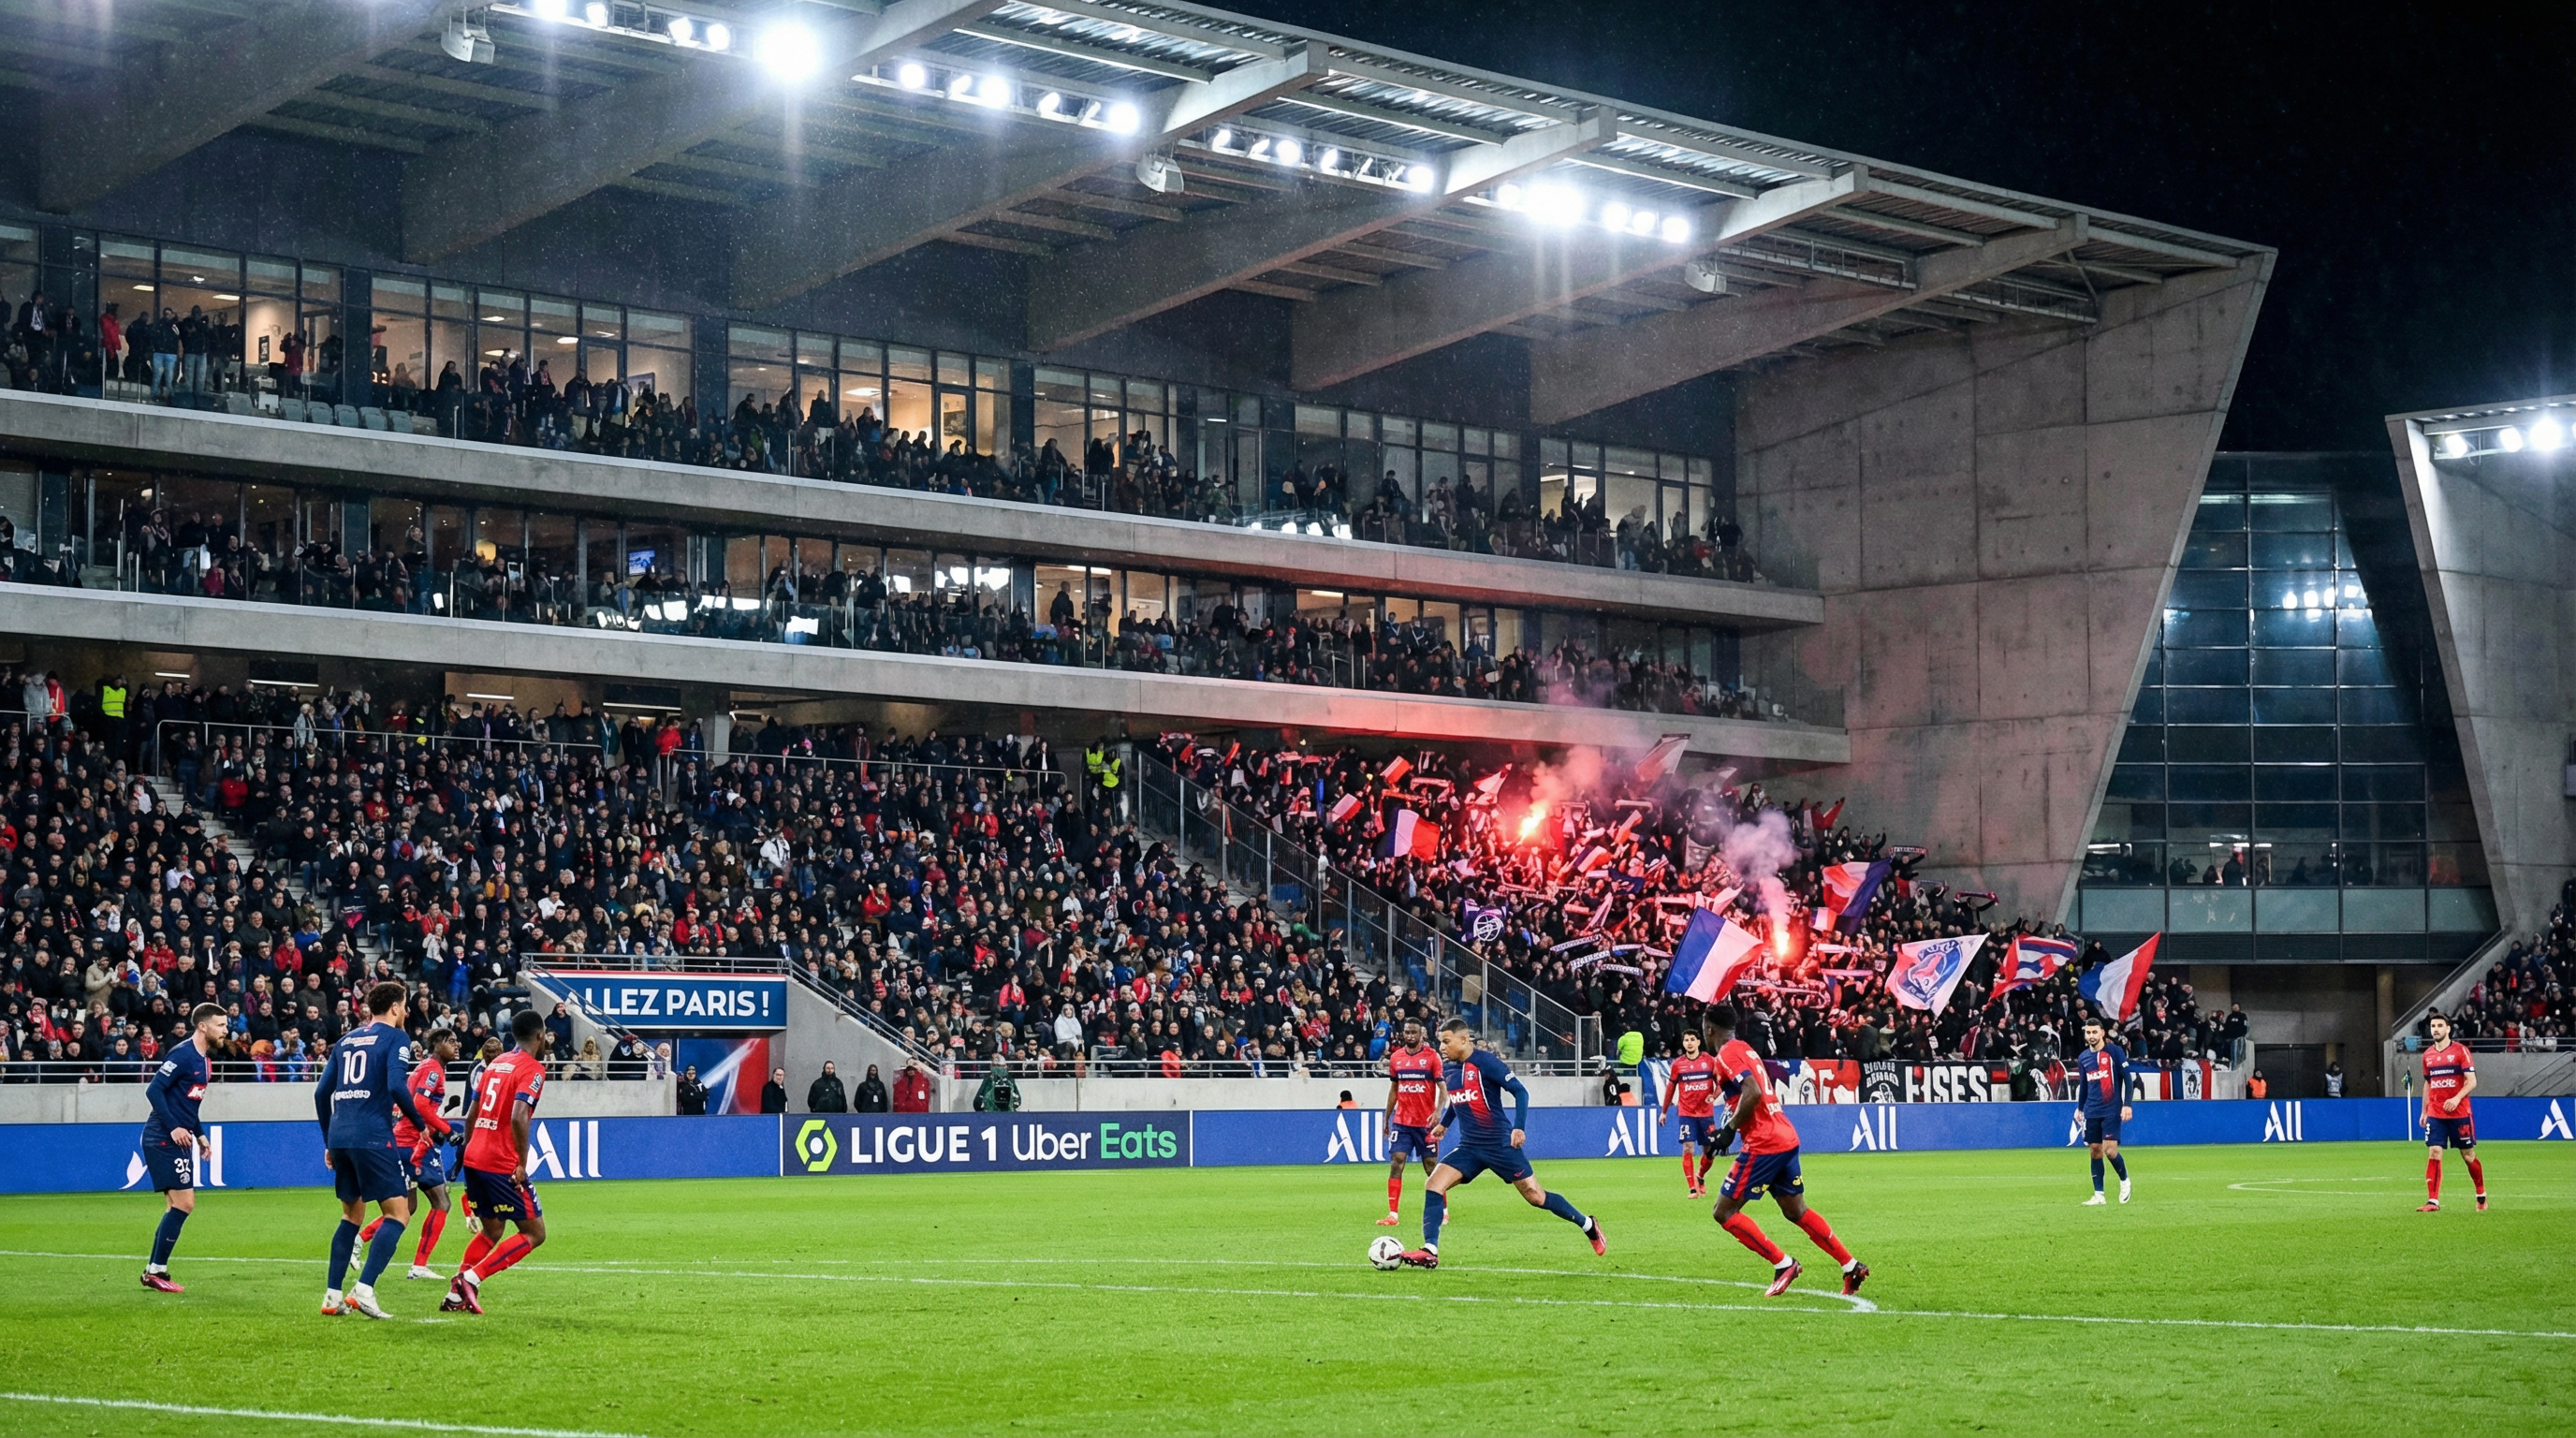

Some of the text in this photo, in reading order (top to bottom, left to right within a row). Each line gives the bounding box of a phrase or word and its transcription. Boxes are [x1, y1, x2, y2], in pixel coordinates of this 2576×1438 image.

[666, 989, 755, 1017] PARIS
[343, 1049, 367, 1085] 10
[482, 1078, 501, 1112] 5
[851, 1123, 1178, 1164] LIGUE 1 Uber Eats
